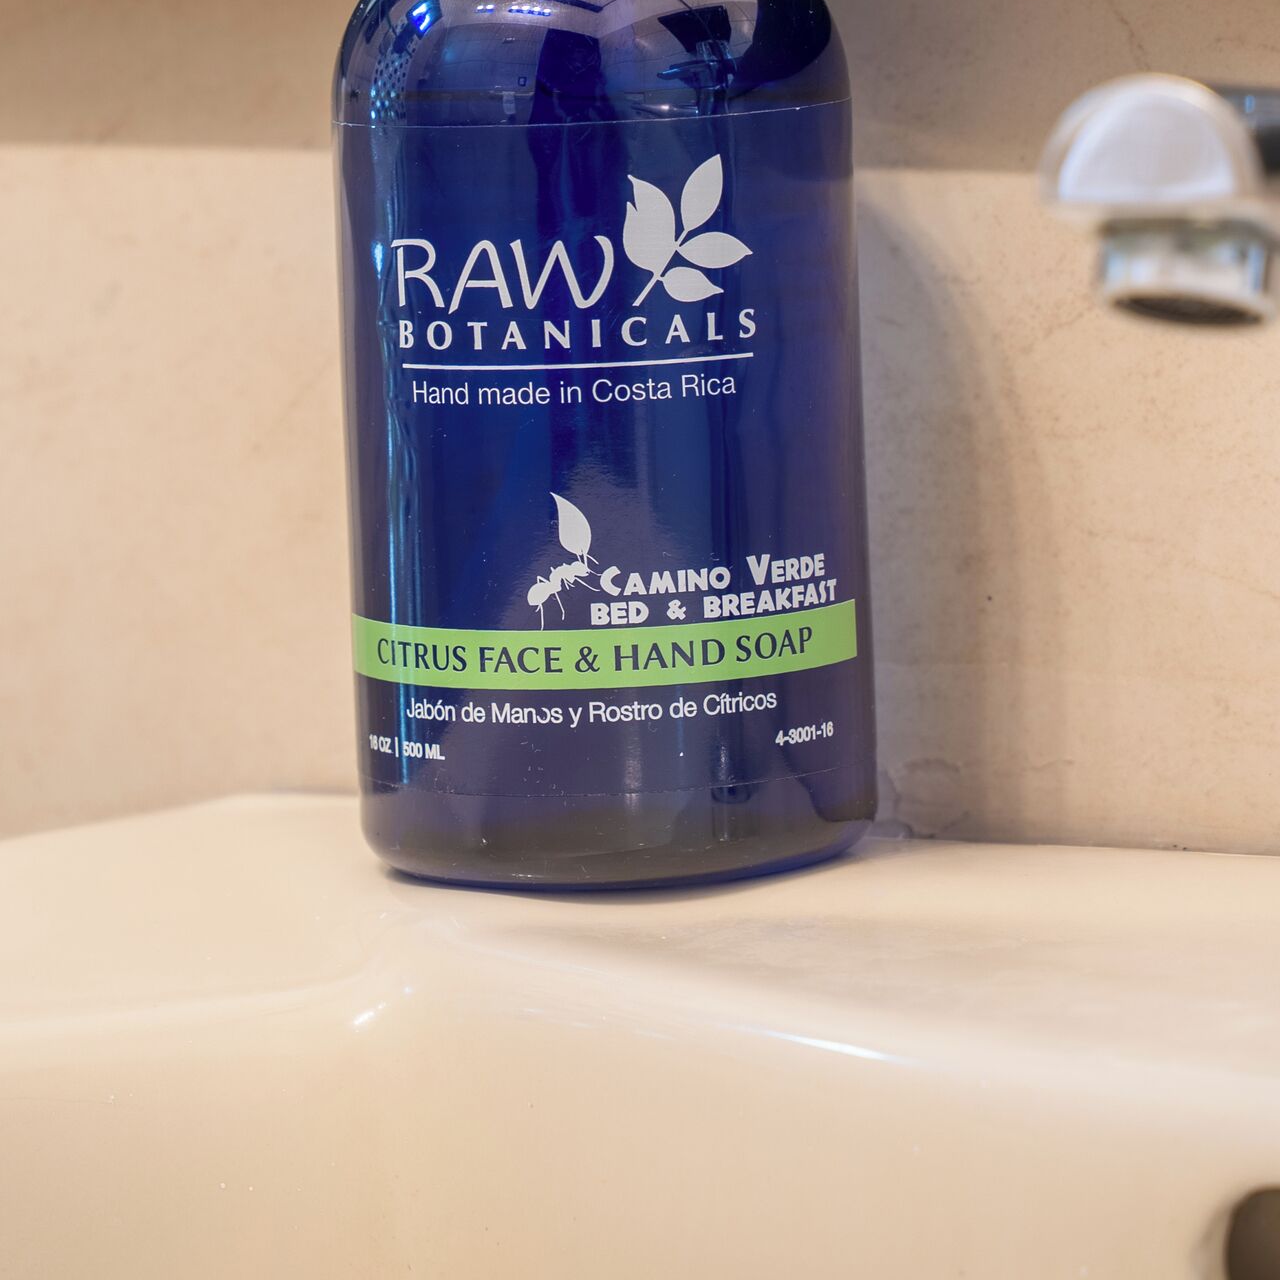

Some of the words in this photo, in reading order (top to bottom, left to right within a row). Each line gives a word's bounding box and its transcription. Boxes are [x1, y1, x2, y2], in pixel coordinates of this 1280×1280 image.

[390, 235, 615, 315] RAW
[398, 308, 757, 351] BOTANICALS
[412, 380, 469, 405] Hand
[478, 381, 551, 405] made
[560, 380, 582, 404] in
[592, 378, 673, 403] Costa
[681, 373, 737, 398] Rica
[599, 565, 732, 597] CAMINO
[745, 552, 826, 586] VERDE
[589, 600, 650, 626] BED
[665, 598, 687, 621] &
[702, 577, 838, 620] BREAKFAST
[377, 638, 468, 672] CITRUS
[479, 646, 564, 674] FACE
[574, 646, 601, 673] &
[613, 638, 726, 672] HAND
[735, 625, 814, 663] SOAP
[406, 697, 456, 722] Jabón
[460, 701, 486, 724] de
[490, 702, 564, 724] Manos
[567, 706, 583, 729] y
[588, 700, 664, 723] Rostro
[669, 696, 698, 719] de
[702, 691, 778, 717] Cítricos
[378, 735, 393, 754] OZ
[402, 740, 423, 759] 500
[424, 743, 446, 761] ML
[775, 721, 834, 746] 4-3001-16
